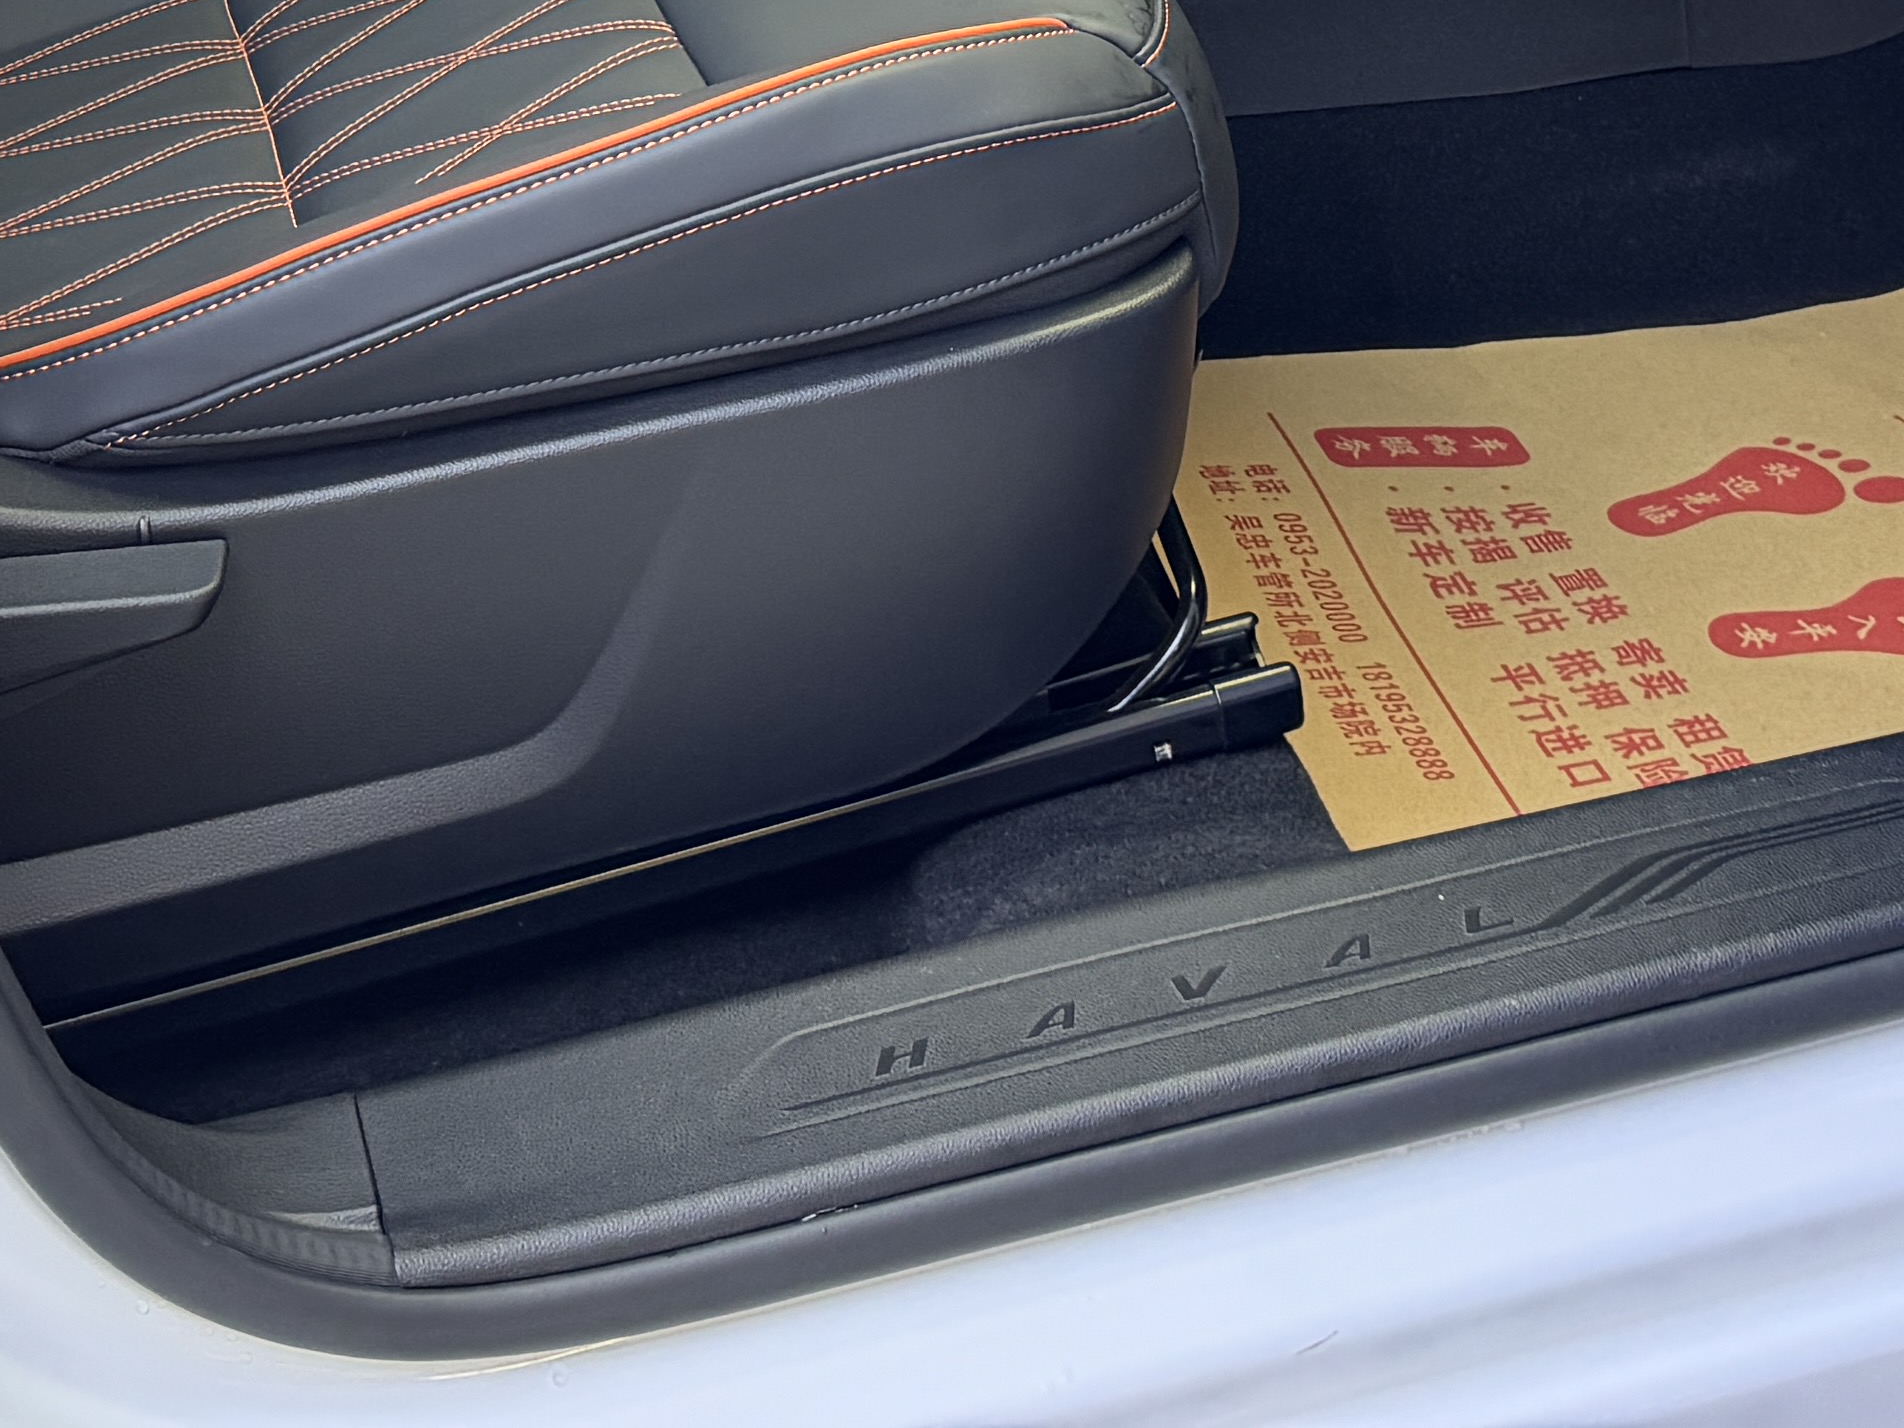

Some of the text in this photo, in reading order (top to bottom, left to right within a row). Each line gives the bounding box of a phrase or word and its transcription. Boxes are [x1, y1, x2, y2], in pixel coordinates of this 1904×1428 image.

[1637, 461, 1801, 526] 欢迎光临
[1495, 578, 1570, 635] 评估
[1546, 648, 1630, 710] 抵押
[1549, 567, 1629, 624] 置换
[1610, 637, 1690, 700] 寄卖
[1356, 661, 1454, 781] 18195328888
[1490, 662, 1612, 788] 平行进口
[874, 906, 1514, 1078] HAVAL
